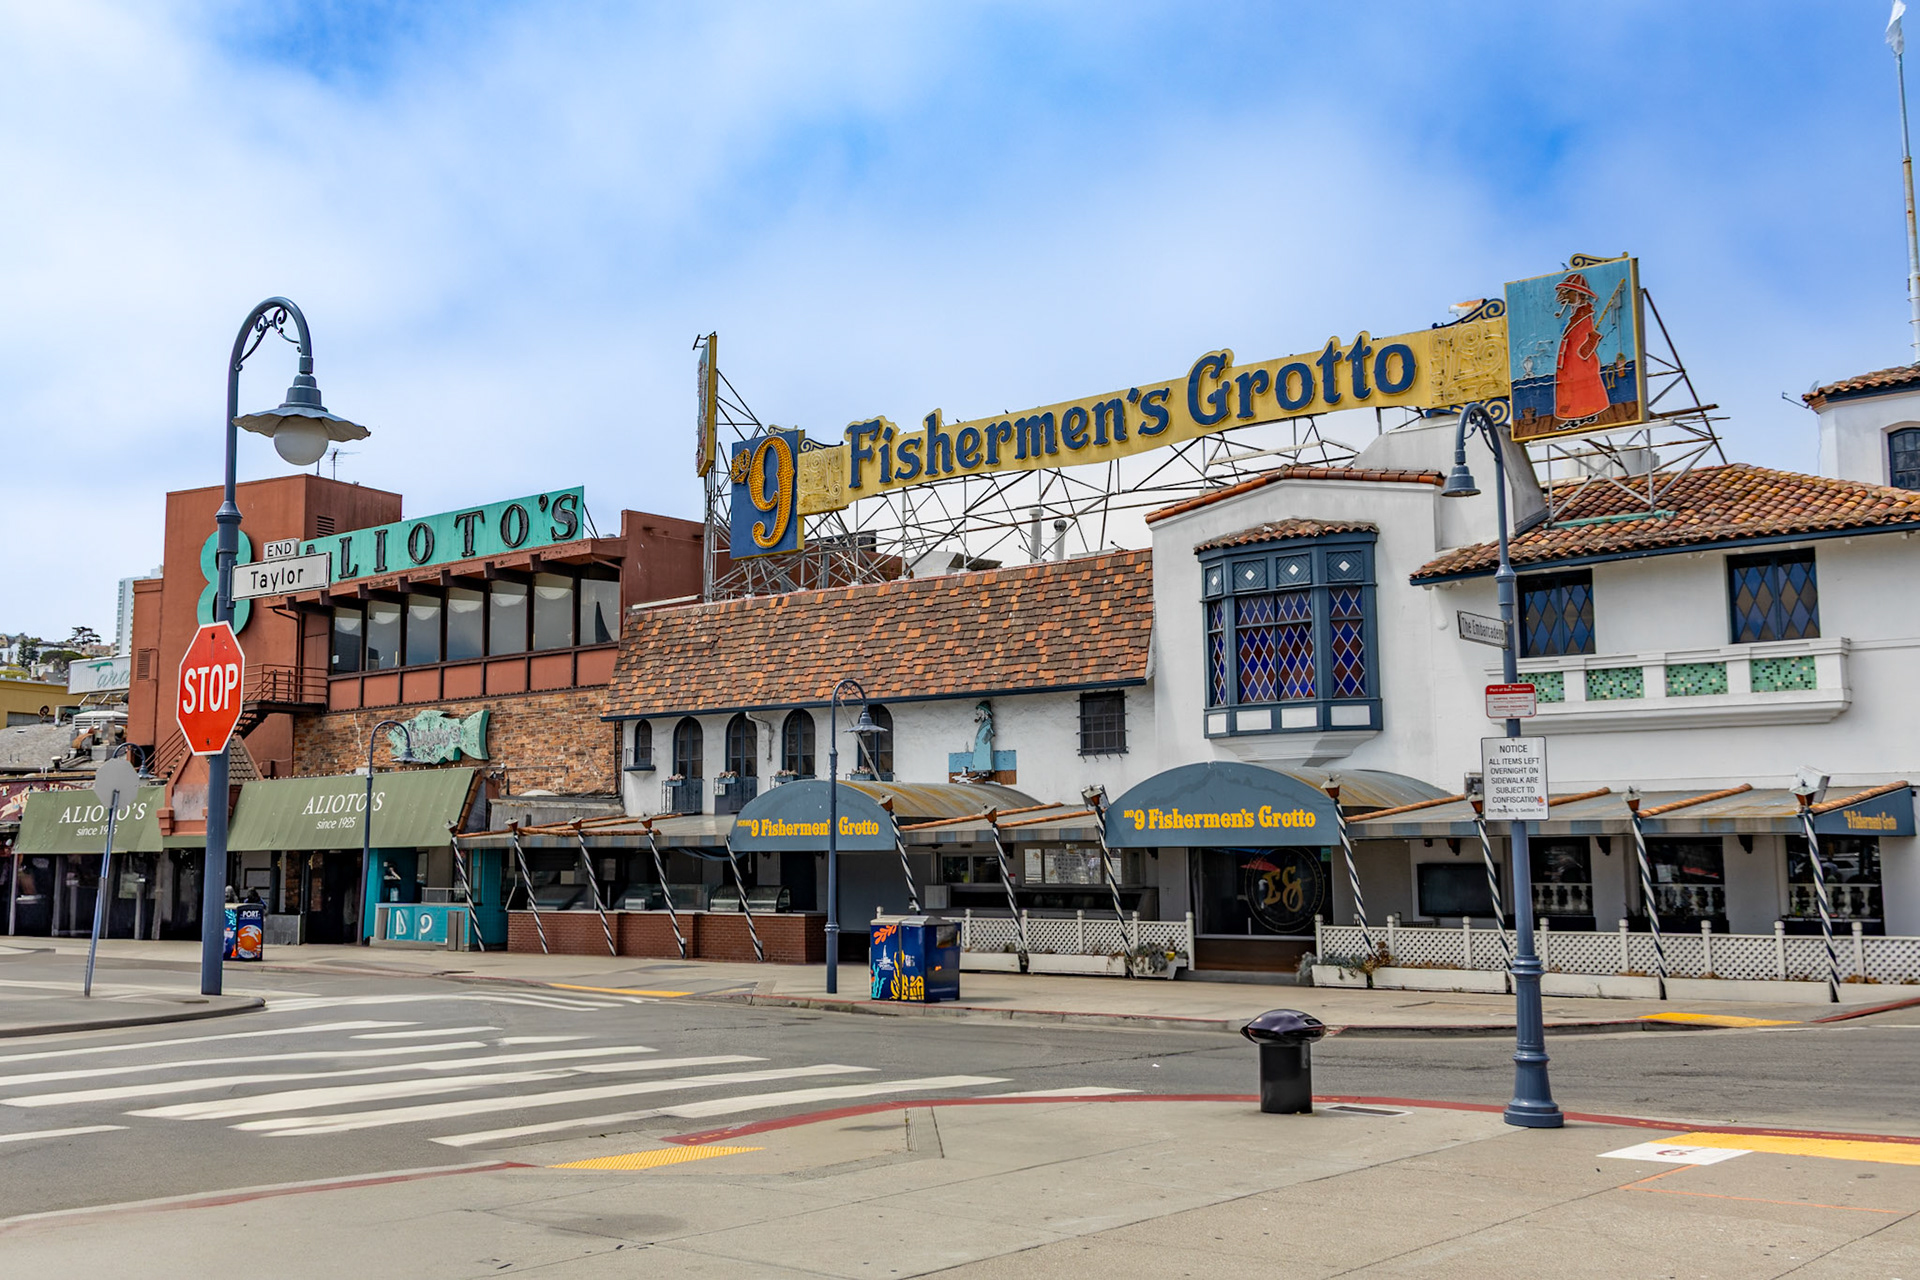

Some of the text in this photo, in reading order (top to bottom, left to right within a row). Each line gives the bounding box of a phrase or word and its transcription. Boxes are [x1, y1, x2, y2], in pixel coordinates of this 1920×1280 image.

[848, 334, 1418, 489] Fishermen's Grotto
[306, 494, 578, 580] LIOTO'S
[267, 542, 292, 557] END
[251, 567, 304, 592] Taylor
[1461, 617, 1472, 634] The
[183, 663, 239, 714] STOP
[1500, 745, 1528, 753] NOTICE
[1490, 767, 1527, 775] OVERNIGHT
[1496, 786, 1525, 794] SUBJECT
[58, 803, 147, 824] ALIOO'S
[1148, 808, 1255, 829] Fishermen's
[1258, 805, 1316, 828] Grotto
[76, 825, 117, 836] since 195
[316, 817, 356, 829] since 1925
[761, 819, 831, 837] Fishermen'
[838, 816, 879, 836] Grotto
[242, 910, 259, 918] PORT
